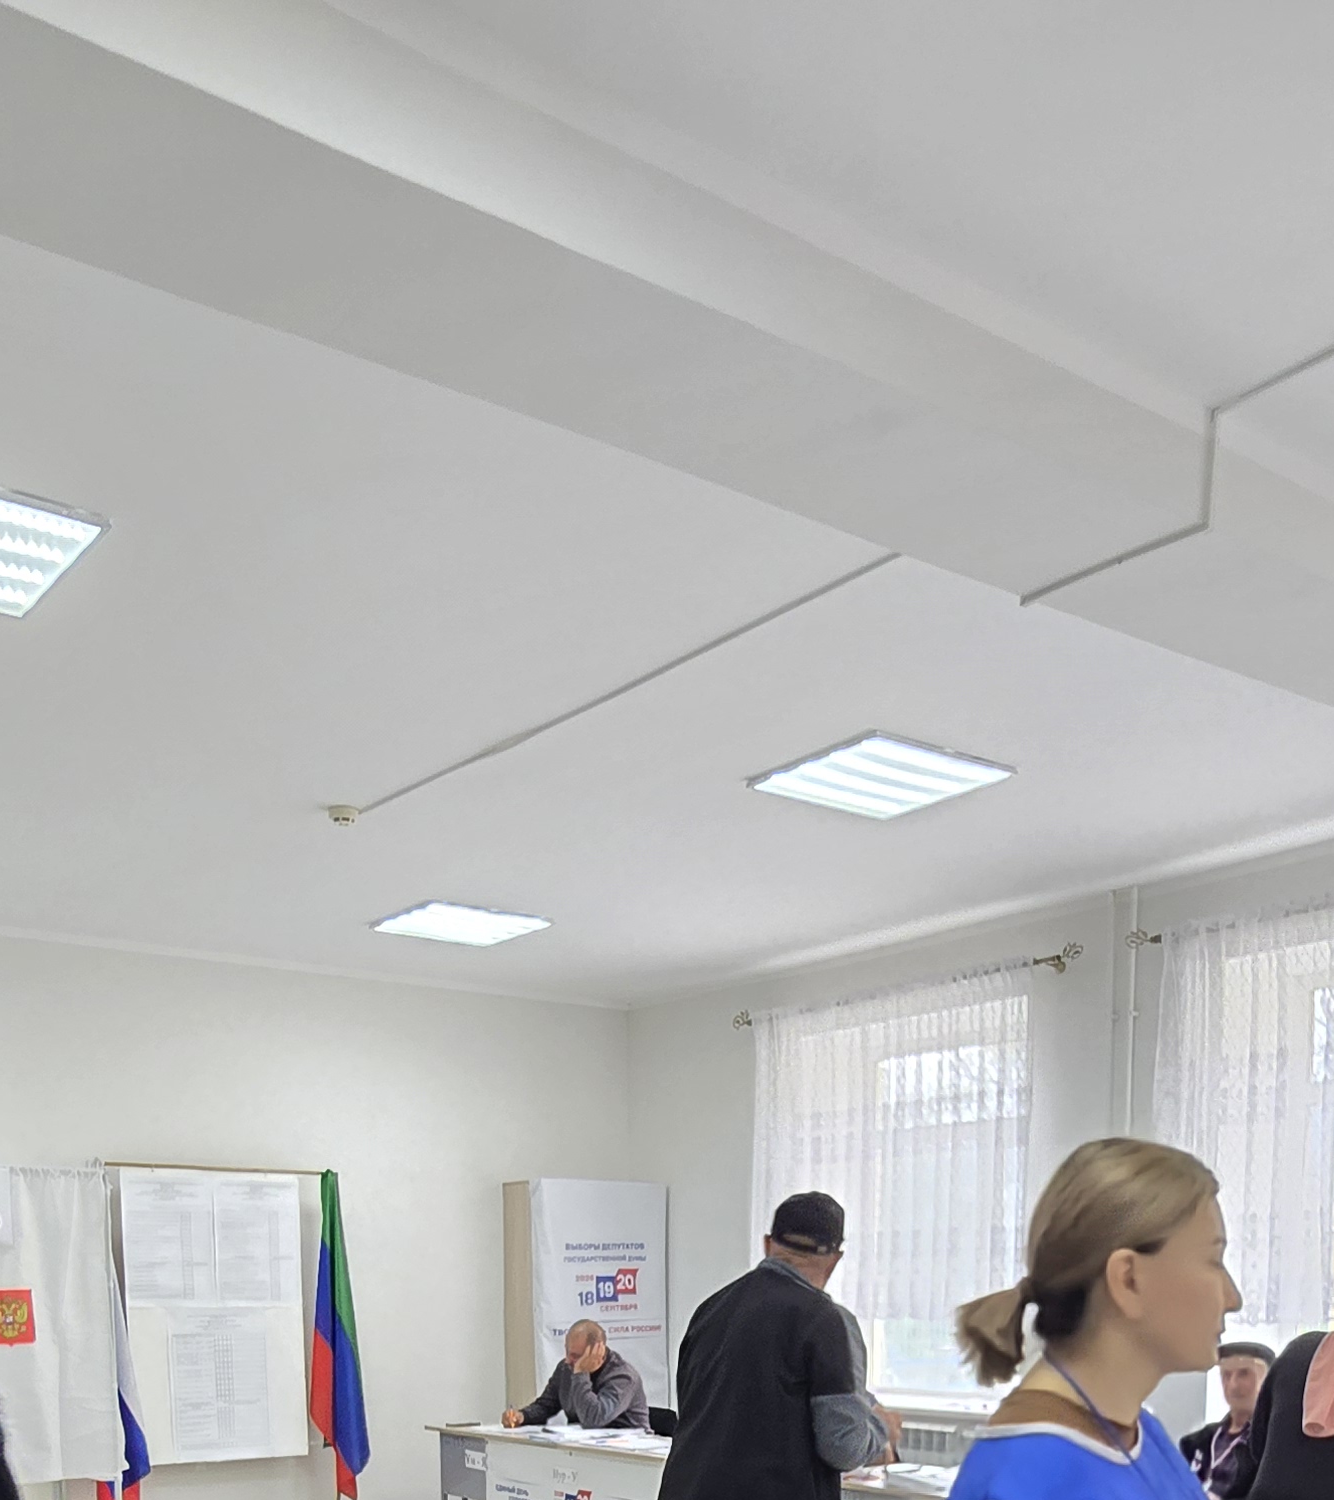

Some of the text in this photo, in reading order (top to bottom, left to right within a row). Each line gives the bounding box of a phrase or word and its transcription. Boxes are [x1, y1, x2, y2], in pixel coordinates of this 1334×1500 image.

[565, 1243, 645, 1251] ВЫБОРЫ ДЕПУТАТОВ
[577, 1274, 634, 1306] 18 19 20
